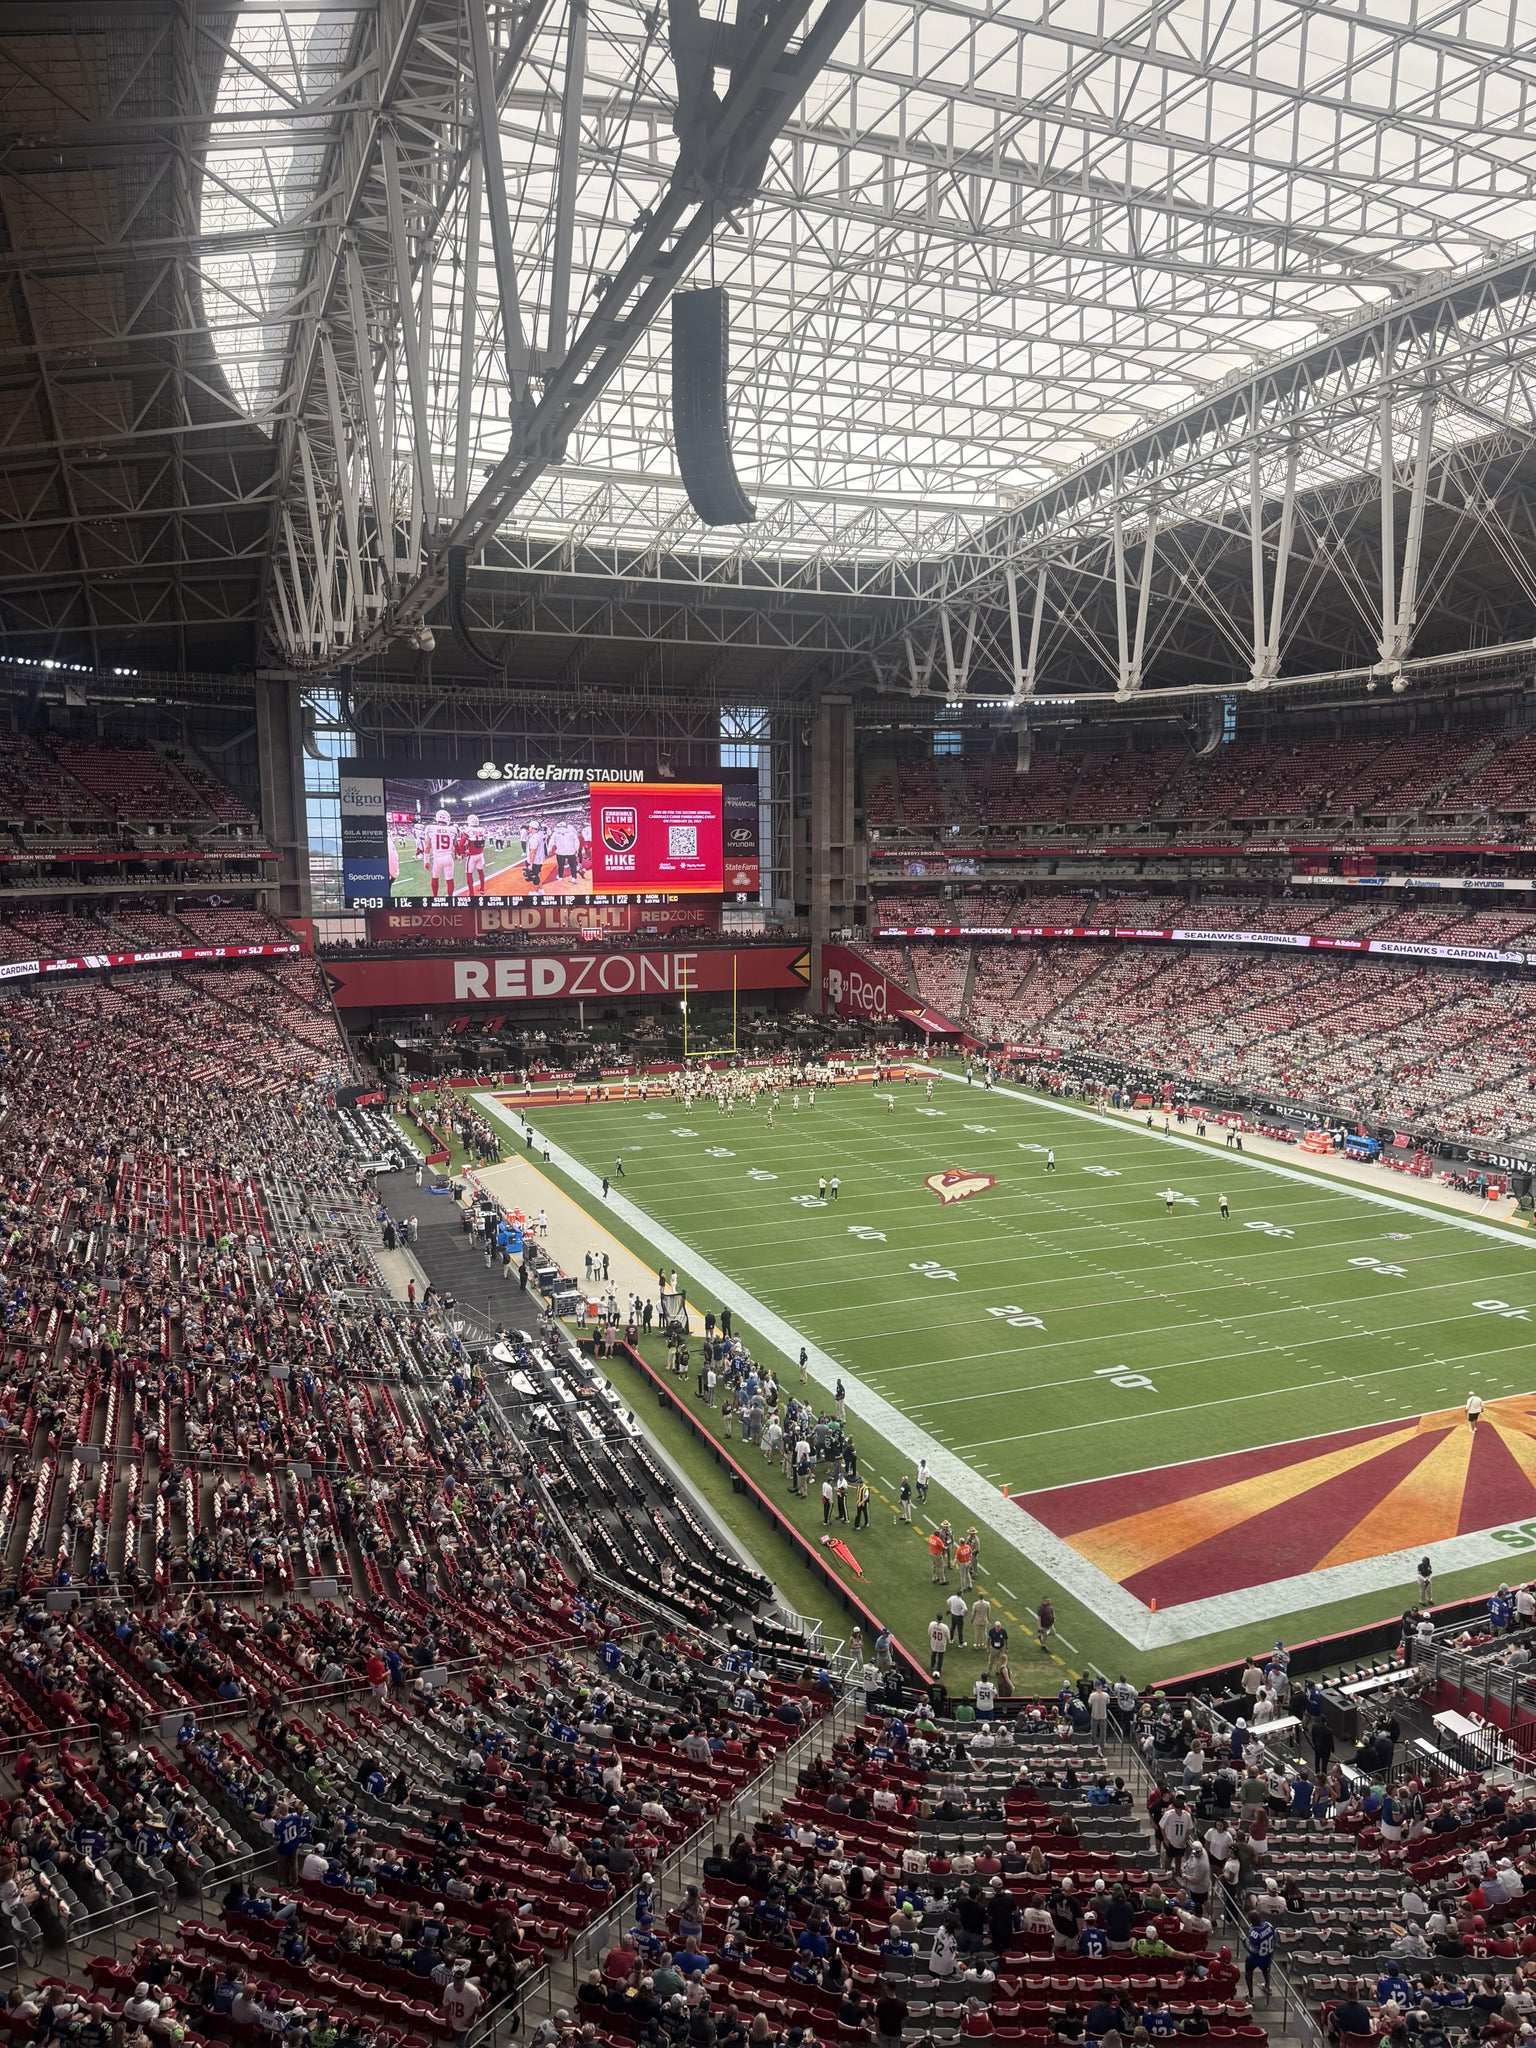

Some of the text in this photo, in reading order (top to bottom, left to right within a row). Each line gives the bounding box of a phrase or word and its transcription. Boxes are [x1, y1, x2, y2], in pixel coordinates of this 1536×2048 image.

[586, 769, 644, 782] STADIUM
[343, 792, 382, 807] cigna
[436, 834, 450, 850] 19
[605, 854, 636, 866] HIKE
[348, 873, 382, 882] Spectrum
[353, 897, 384, 908] 29:03
[481, 907, 625, 930] BUD LIGHT
[1184, 932, 1298, 944] SEAHAWKS CARDINALS
[134, 951, 182, 961] B.GILLIKIN
[1380, 943, 1438, 955] SEAHAWKS
[0, 962, 38, 976] CARDINAL
[46, 962, 78, 970] SEASON
[850, 972, 886, 1013] Red
[704, 1146, 736, 1158] 30
[746, 1167, 779, 1180] 40
[790, 1194, 828, 1208] 50
[847, 1226, 887, 1240] 40
[1243, 1221, 1295, 1237] 30
[908, 1261, 957, 1279] 30
[1347, 1256, 1409, 1275] 20
[985, 1305, 1044, 1327] 20
[1472, 1300, 1531, 1318] 10
[1093, 1364, 1153, 1388] 10
[932, 1632, 943, 1641] 40
[864, 1673, 873, 1681] 25
[980, 1691, 990, 1700] 54
[734, 1696, 746, 1710] 51
[1270, 1780, 1280, 1792] 12
[283, 1824, 298, 1844] 10
[1175, 1824, 1184, 1836] 11
[727, 1916, 740, 1932] 12
[934, 1942, 944, 1957] 12
[1088, 1942, 1102, 1958] 12
[1472, 1945, 1488, 1958] 13
[1390, 1990, 1407, 2005] 12
[1152, 2026, 1168, 2036] 12
